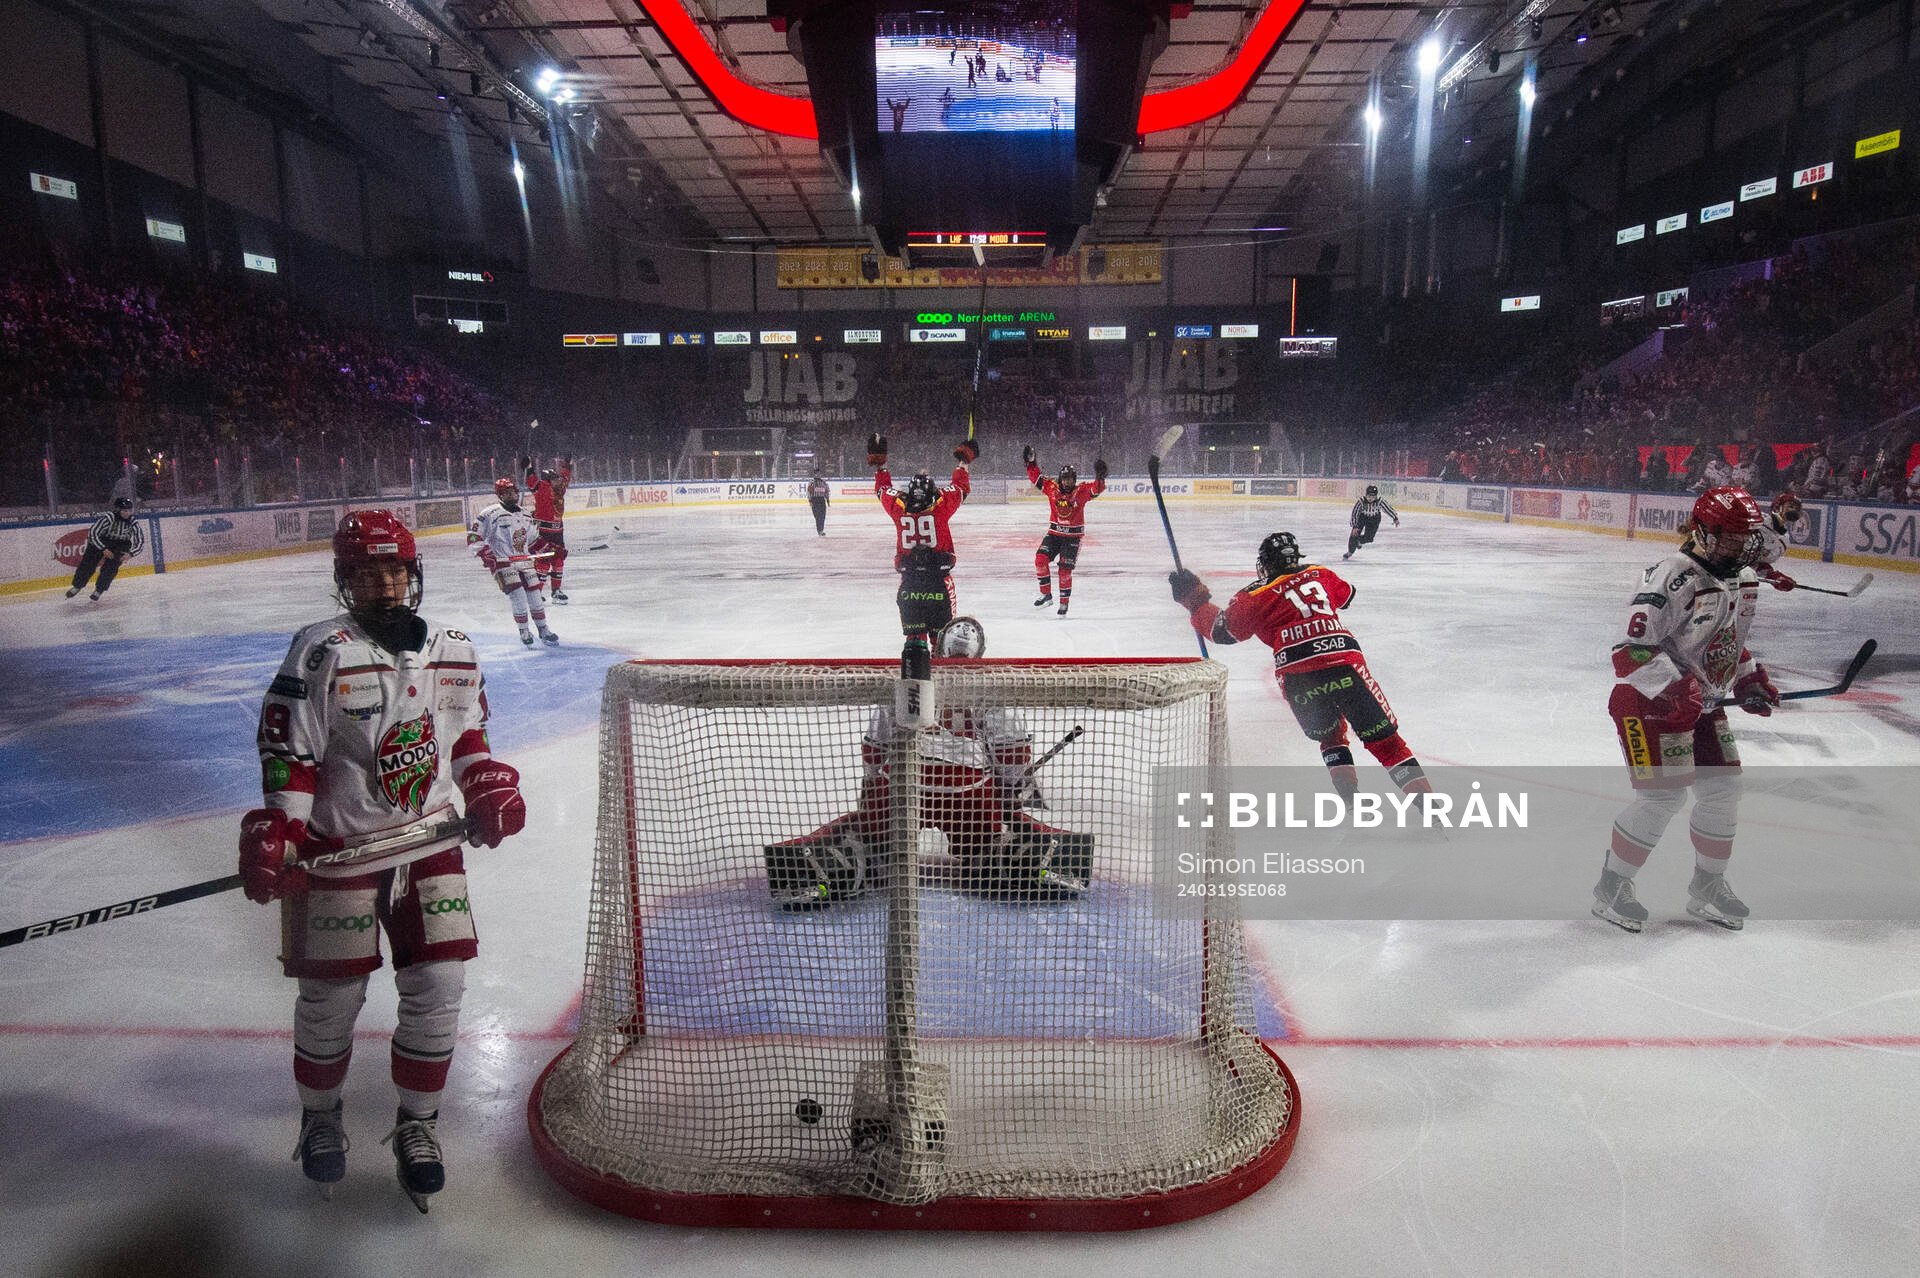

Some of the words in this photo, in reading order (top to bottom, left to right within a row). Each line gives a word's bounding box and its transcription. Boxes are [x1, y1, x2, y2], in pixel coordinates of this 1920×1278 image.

[1800, 166, 1825, 185] ABB
[448, 270, 471, 281] NIEMI
[472, 273, 484, 282] BIL
[917, 313, 953, 325] coop
[1019, 312, 1055, 322] ARENA
[631, 335, 649, 345] WIST
[763, 333, 792, 343] office
[1037, 329, 1069, 337] TITAN
[743, 351, 858, 403] JIAB
[728, 484, 775, 495] FOMAB
[1638, 507, 1675, 531] NIEMI
[901, 515, 938, 549] 29
[1855, 512, 1920, 558] SSA
[910, 592, 945, 601] NYAB
[1285, 580, 1334, 619] 13
[1627, 612, 1648, 638] 6
[1313, 637, 1346, 653] SSAB
[1305, 676, 1354, 700] NYAB
[379, 739, 437, 774] MODO
[23, 896, 159, 943] BAUER
[311, 912, 374, 933] coop
